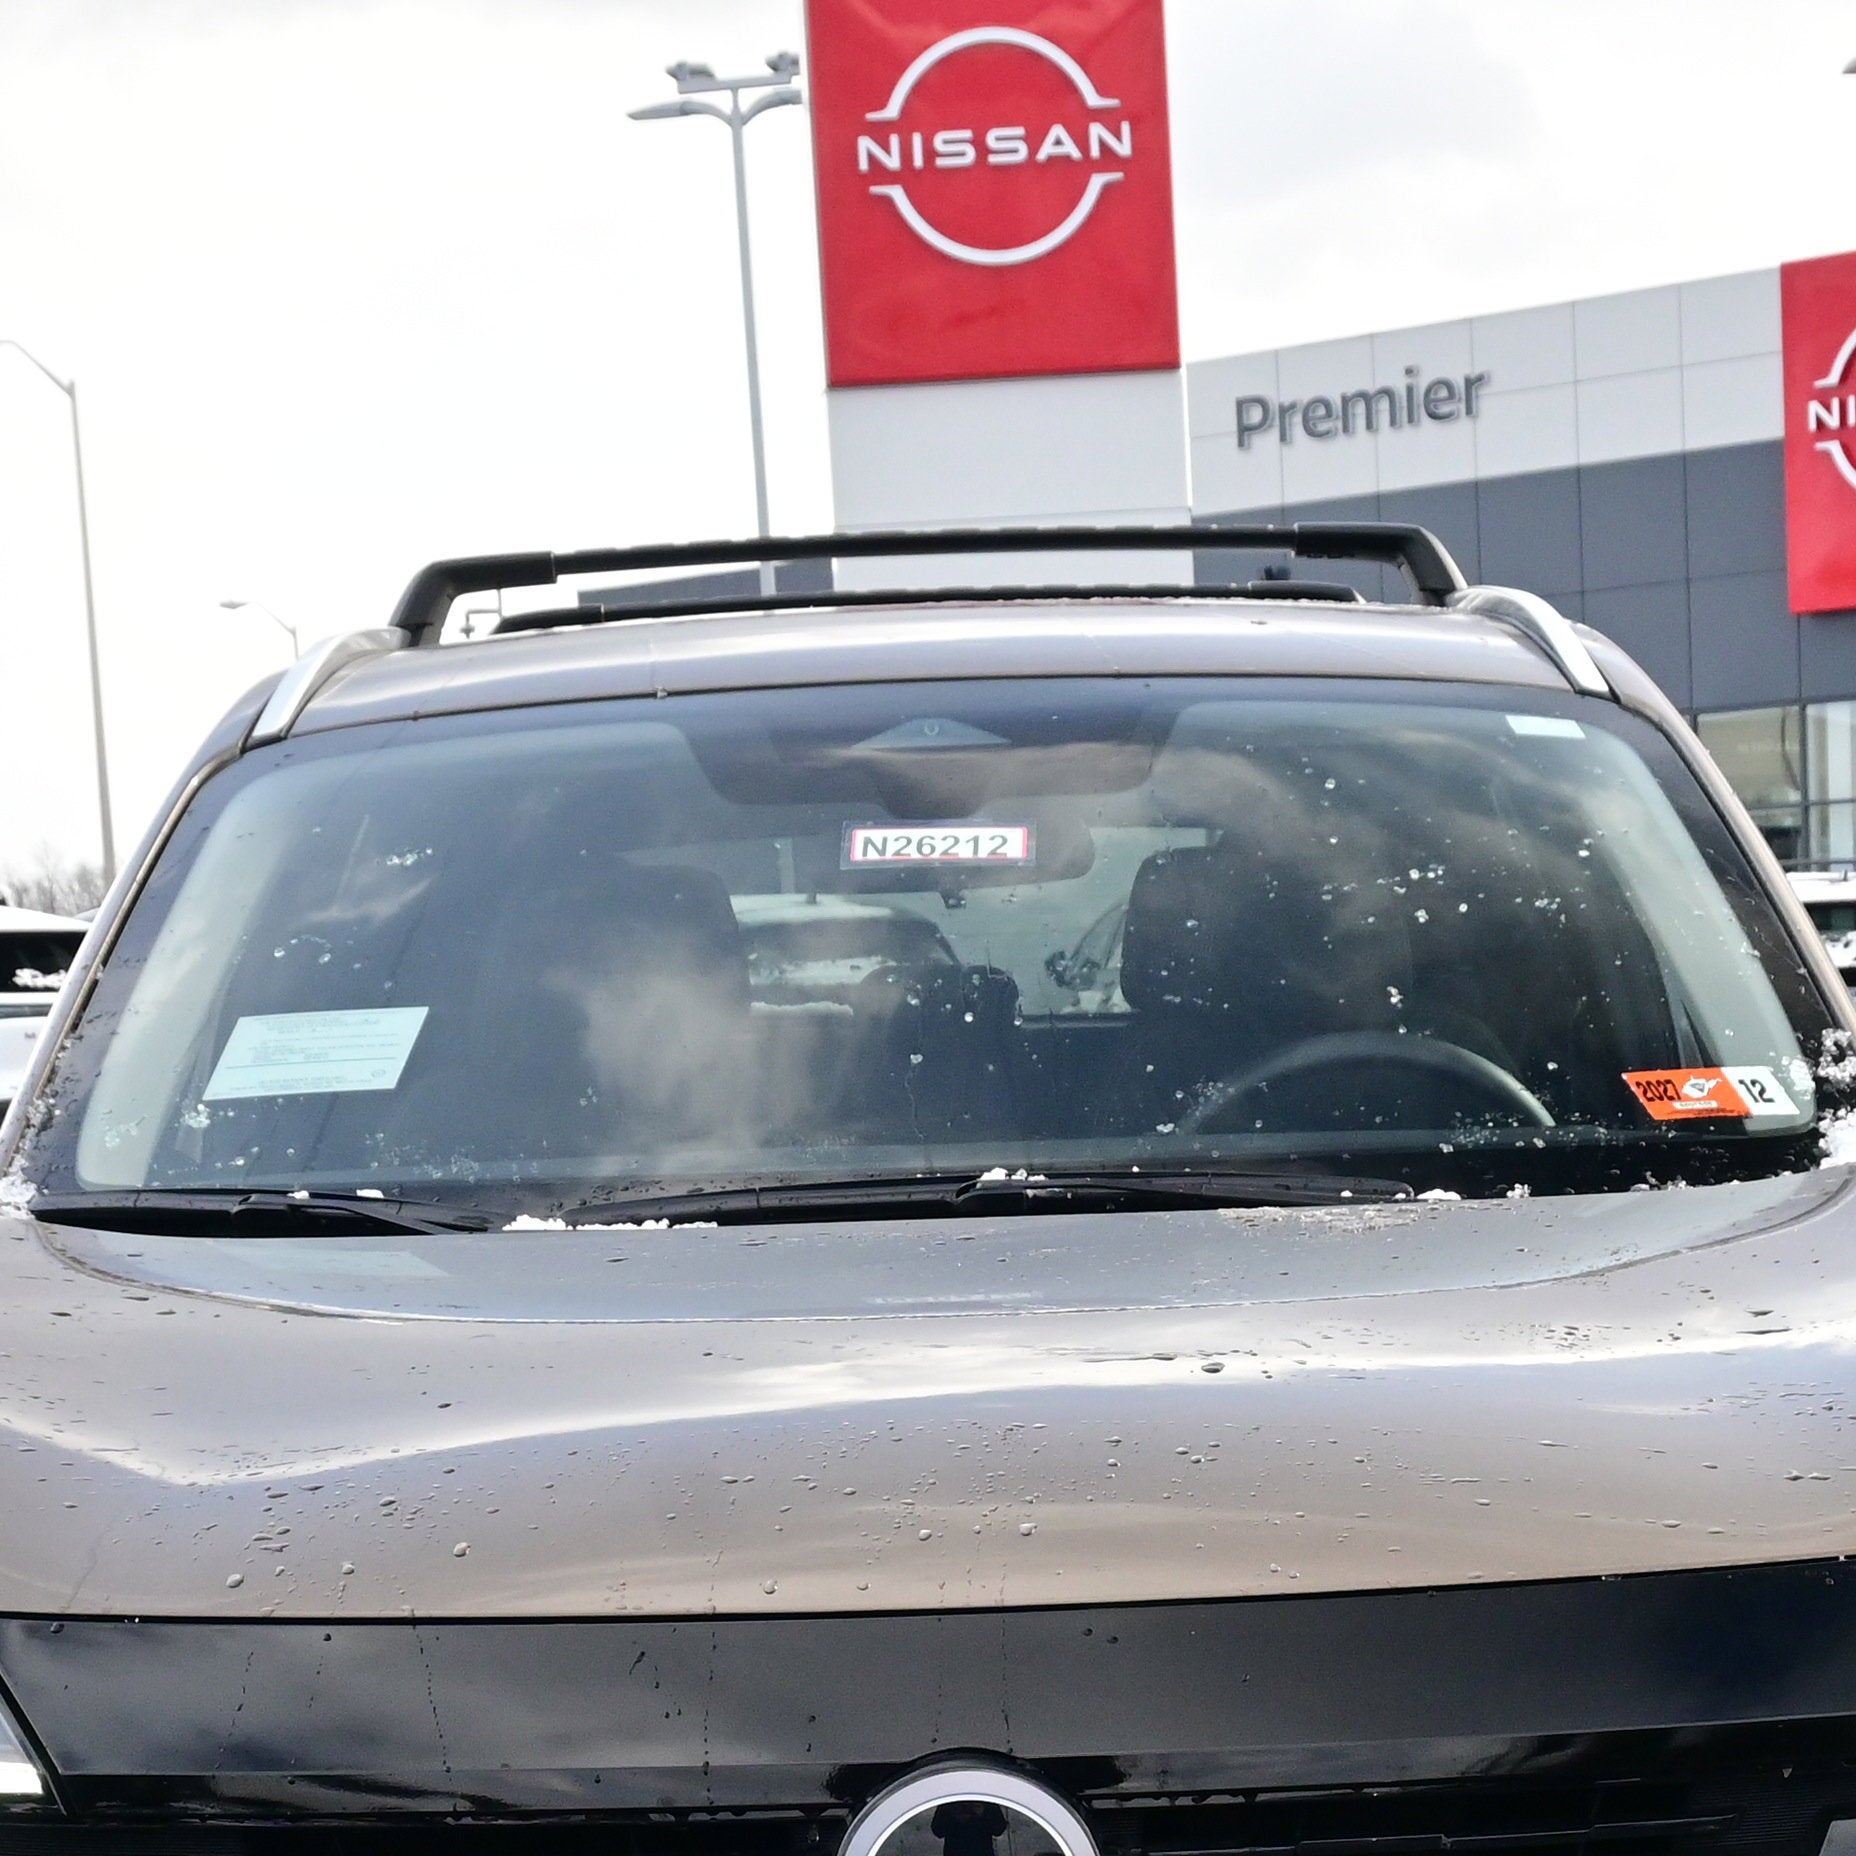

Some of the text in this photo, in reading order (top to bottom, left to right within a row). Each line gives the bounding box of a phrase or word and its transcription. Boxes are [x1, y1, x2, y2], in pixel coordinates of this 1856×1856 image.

[856, 120, 1133, 174] NISSAN
[1235, 364, 1489, 450] Premier
[861, 834, 1010, 858] N26212
[1635, 1078, 1682, 1103] 2027
[1737, 1078, 1775, 1104] 12
